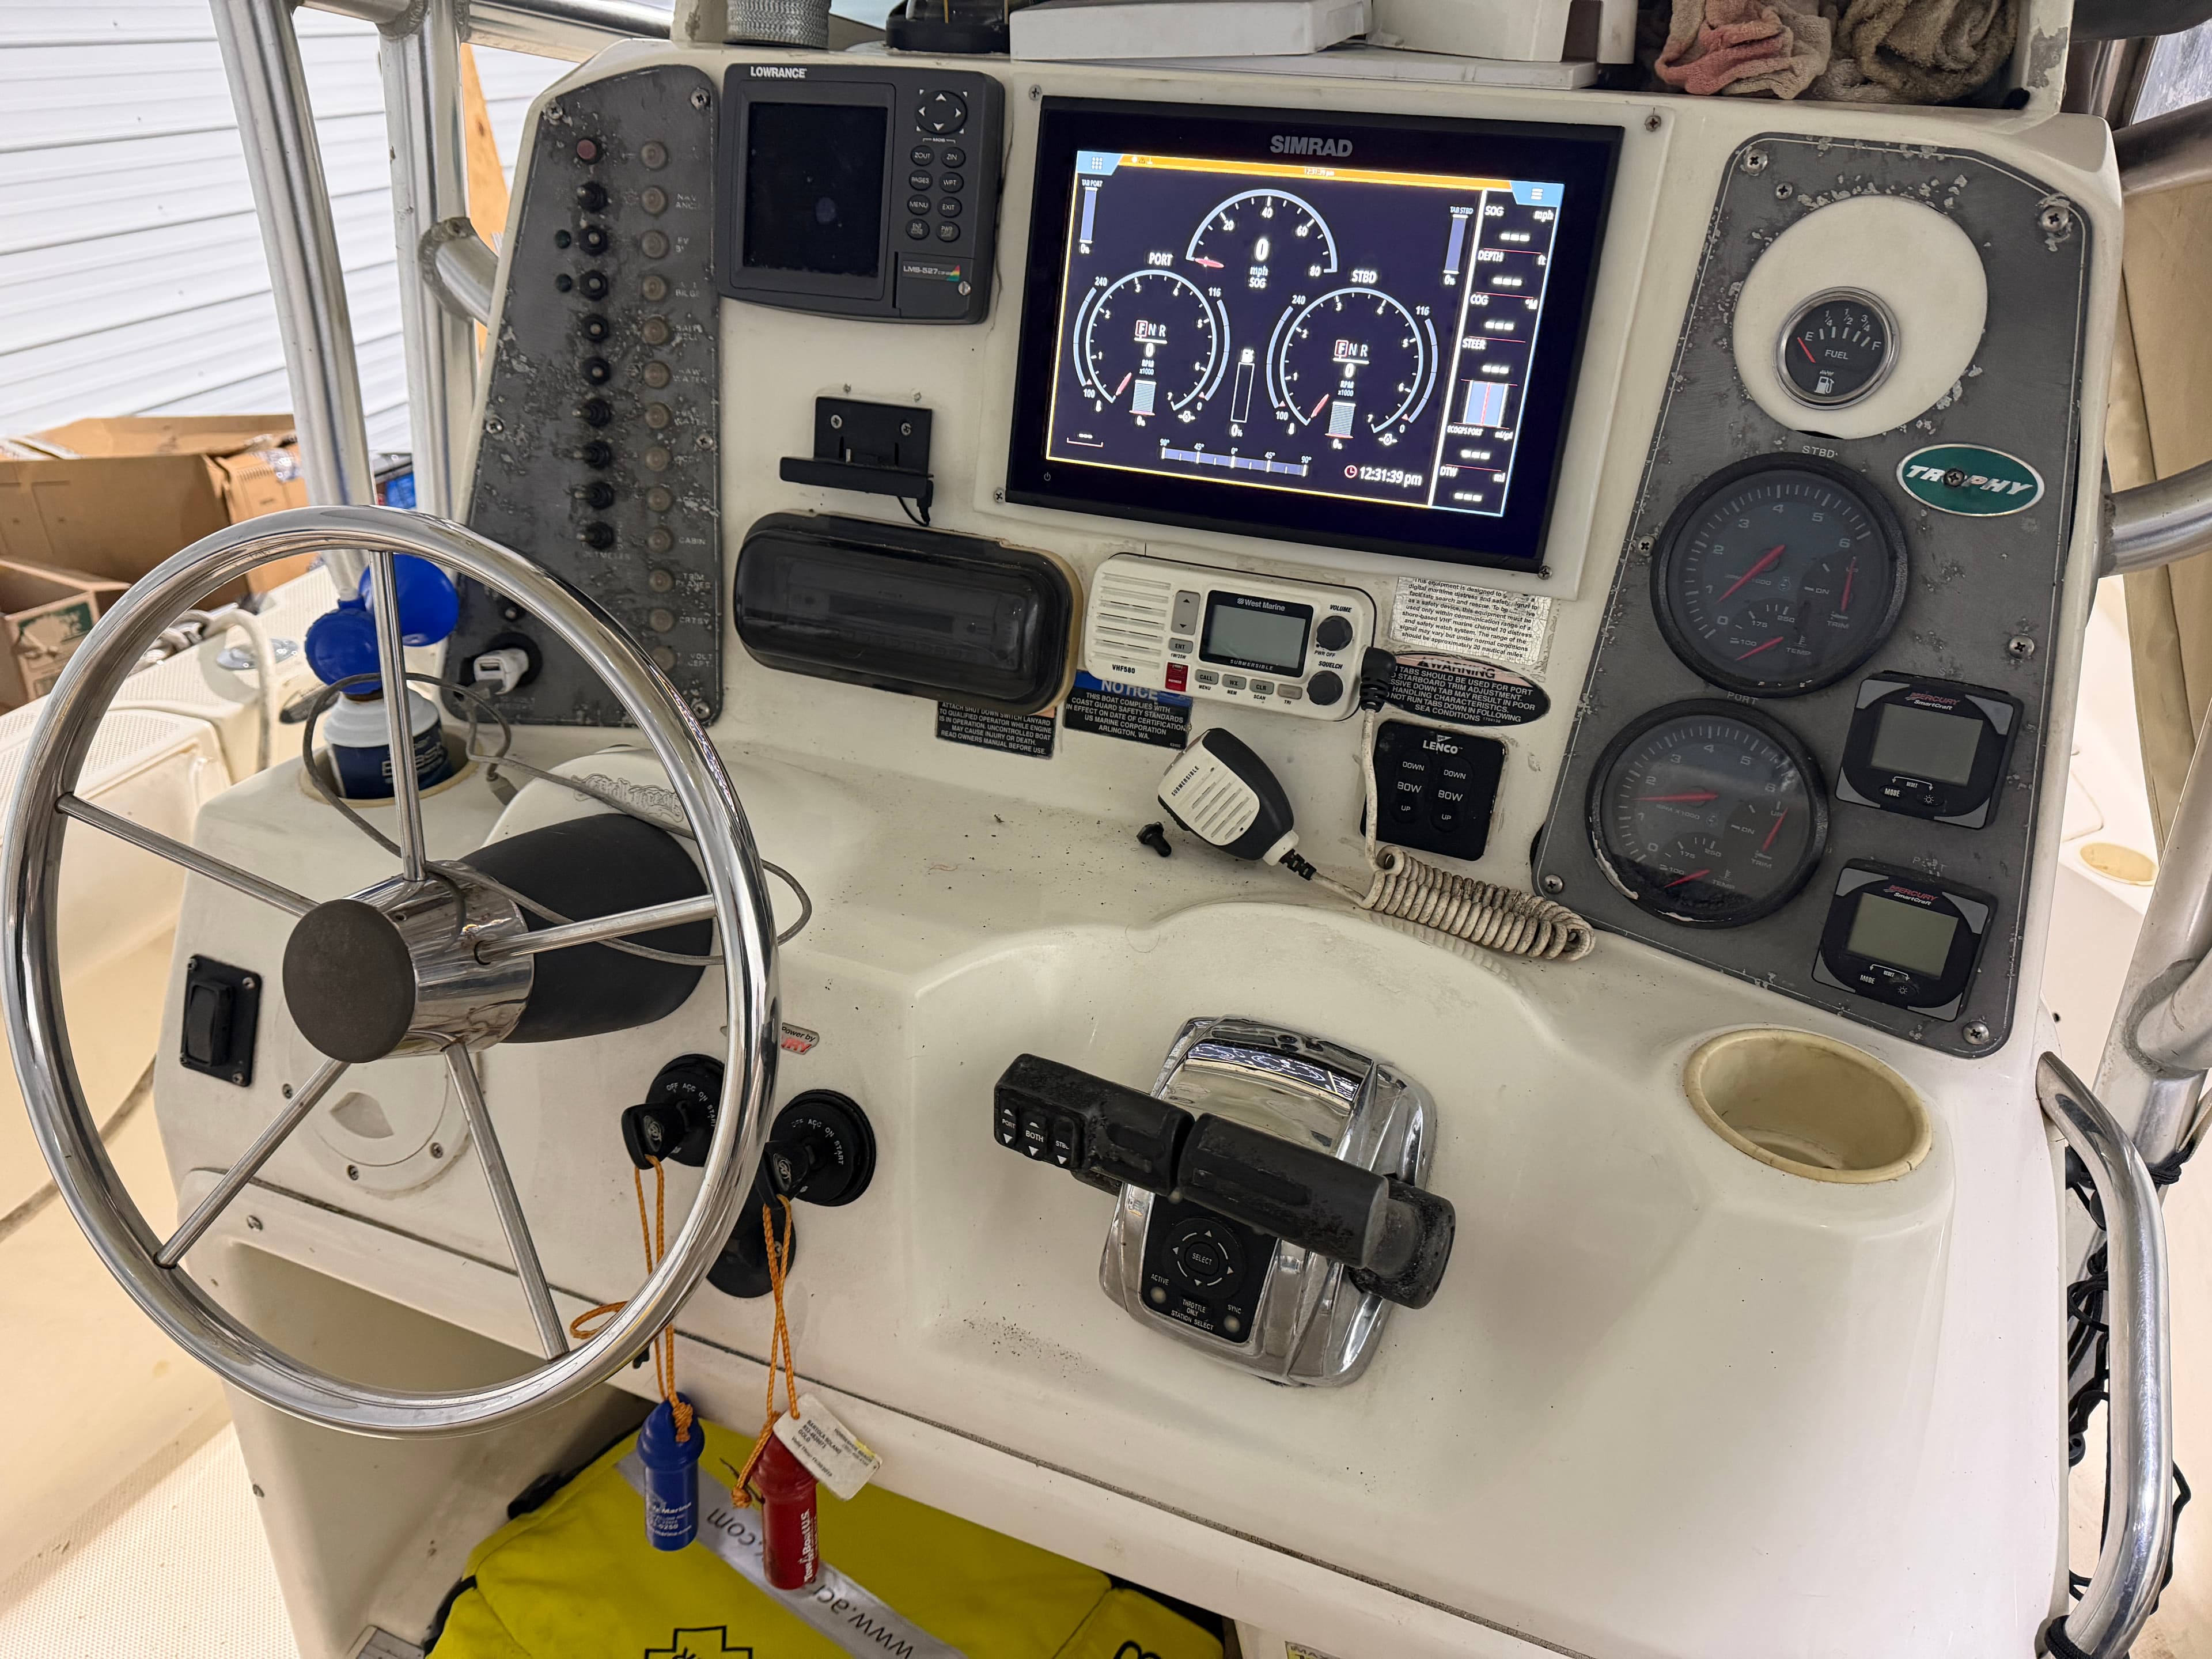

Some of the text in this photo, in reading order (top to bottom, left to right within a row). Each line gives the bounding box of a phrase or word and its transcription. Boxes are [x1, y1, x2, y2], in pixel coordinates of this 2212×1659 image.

[751, 66, 806, 78] LOWRANCE
[1270, 135, 1353, 157] SIMRAD
[1262, 207, 1273, 218] 40
[1484, 206, 1504, 216] SOG
[1534, 210, 1554, 222] mph
[1223, 221, 1234, 231] 20
[1297, 226, 1308, 237] 60
[1255, 238, 1269, 261] 0
[1149, 252, 1173, 266] PORT
[1478, 250, 1503, 262] DEPTH
[1249, 266, 1268, 276] mph
[1309, 266, 1320, 276] 80
[1351, 270, 1377, 283] STBD
[1095, 276, 1107, 286] 240
[1249, 277, 1266, 288] SOG
[1209, 287, 1221, 297] 116
[1291, 295, 1306, 305] 240
[1470, 294, 1488, 305] COG
[1415, 306, 1430, 316] 116
[1805, 331, 1814, 341] E
[1145, 343, 1154, 357] 0
[1349, 343, 1368, 357] N R
[1462, 338, 1486, 350] STEER
[1872, 341, 1881, 350] F
[1825, 350, 1849, 359] FUEL
[1345, 363, 1354, 377] 0
[1083, 388, 1095, 398] 100
[1275, 411, 1289, 421] 100
[1231, 423, 1243, 437] 0%
[1802, 445, 1835, 459] STBD
[1359, 467, 1422, 487] 12:31:39 pm
[1440, 466, 1458, 477] DTW
[1906, 465, 2033, 495] TRPHY
[1772, 503, 1785, 514] 4
[1812, 512, 1824, 522] 5
[679, 537, 706, 545] CABIN
[1244, 599, 1285, 611] West Marine
[1330, 604, 1352, 613] VOLUME
[1777, 615, 1795, 623] 250
[1826, 620, 1849, 630] TRIM
[1431, 637, 1472, 650] approximately
[1482, 646, 1506, 655] nautical
[1786, 647, 1812, 656] TEMP
[1112, 664, 1135, 673] VHF580
[1230, 659, 1274, 671] SUBMERSIBLE
[1318, 661, 1343, 670] SQUELCH
[1399, 665, 1533, 696] TABS SHOULD BE USED FOR PORT
[1392, 686, 1432, 699] HANDLING
[1397, 673, 1523, 702] STARBOARD TRIM ADJUSTMENT.
[1413, 683, 1536, 711] DOWN TAB MAY RESULT POOR
[1727, 691, 1758, 706] PORT
[1101, 695, 1119, 703] BOAT
[1120, 698, 1152, 710] COMPLIES
[1154, 705, 1171, 713] WITH
[1914, 699, 1953, 710] SmartCraft
[1071, 697, 1183, 724] COAST GUARD SAFETY STANDARDS
[1415, 704, 1430, 713] SEA
[1432, 707, 1480, 722] CONDITIONS
[948, 710, 978, 720] QUALIFIED
[979, 715, 1009, 726] OPERATOR
[1011, 721, 1029, 729] WHILE
[1030, 725, 1052, 734] ENGINE
[1094, 717, 1119, 726] MARINE
[1120, 721, 1166, 735] CORPORATION
[941, 730, 1032, 752] READ OWNERS MANUAL BEFORE
[1422, 740, 1458, 755] LENCO
[1403, 761, 1425, 771] DOWN
[1444, 770, 1466, 779] DOWN
[1171, 766, 1200, 797] SUBMERSIBLE
[1397, 782, 1422, 793] BOW
[1438, 790, 1463, 802] BOW
[1884, 788, 1900, 797] MODE
[1893, 892, 1931, 906] SmartCraft
[1859, 975, 1876, 984] MODE
[782, 1027, 805, 1037] Power
[666, 1082, 716, 1128] OFF ACC ON START
[1002, 1119, 1016, 1128] PORT
[808, 1119, 844, 1165] ACC ON START
[1025, 1130, 1044, 1142] BOTH
[1192, 1253, 1213, 1265] SELECT
[1151, 1274, 1169, 1285] ACTIVE
[1183, 1299, 1206, 1313] THROTTLE
[1187, 1308, 1198, 1316] ONLY
[1228, 1305, 1241, 1314] SYNC
[1171, 1310, 1214, 1331] STATION SELECT
